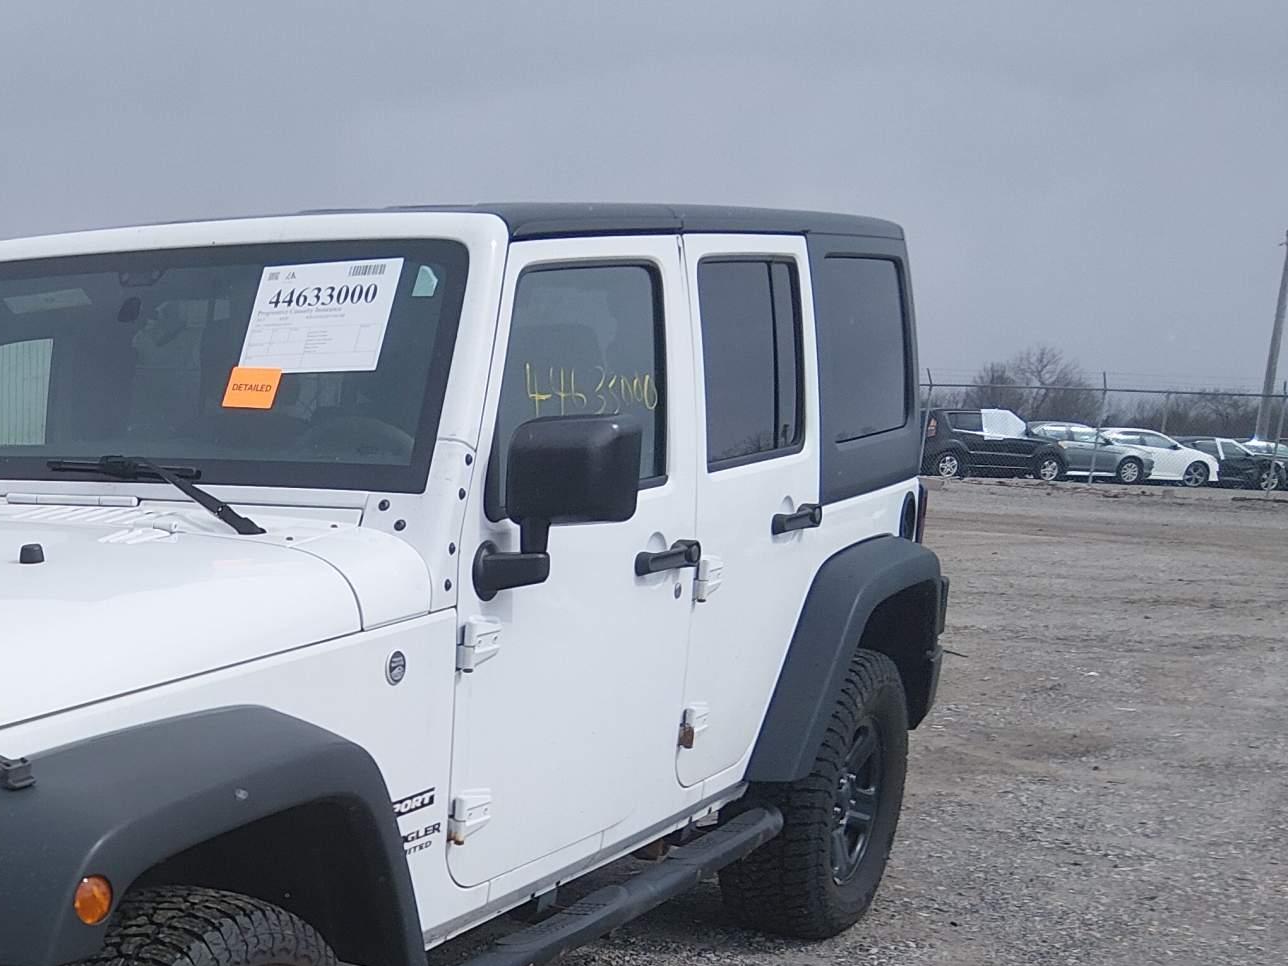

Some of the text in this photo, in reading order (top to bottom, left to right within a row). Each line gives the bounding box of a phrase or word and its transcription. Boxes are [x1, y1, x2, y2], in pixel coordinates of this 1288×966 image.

[268, 283, 379, 309] 44633000
[232, 383, 272, 393] DETAILED
[392, 792, 435, 814] PORT
[404, 822, 441, 843] GLER
